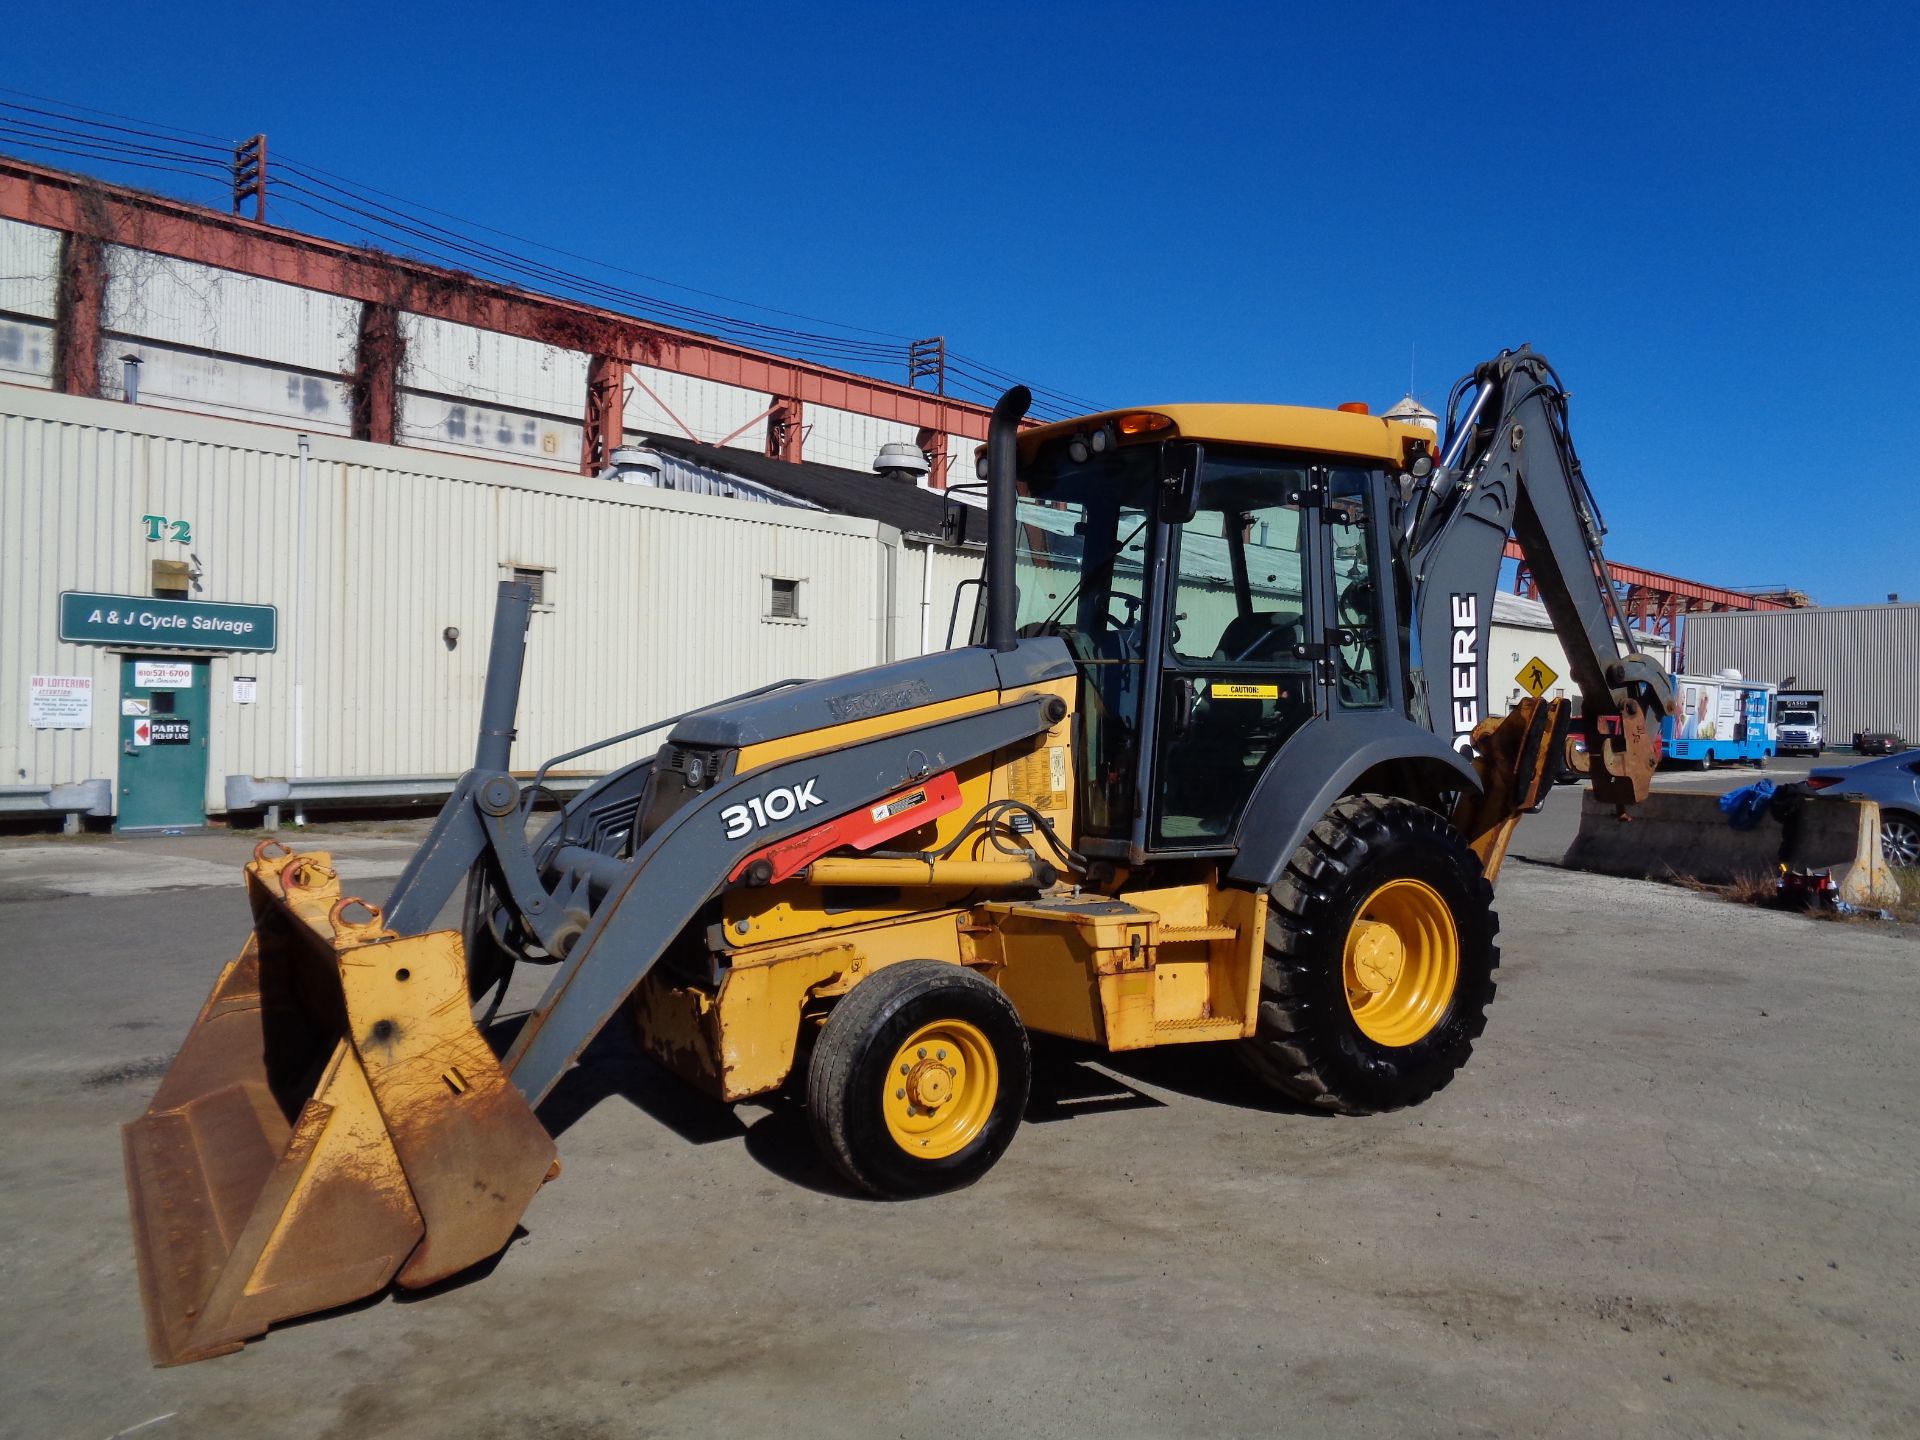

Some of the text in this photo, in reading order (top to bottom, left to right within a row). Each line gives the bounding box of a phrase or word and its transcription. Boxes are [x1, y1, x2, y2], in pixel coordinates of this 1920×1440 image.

[141, 514, 193, 544] T2
[88, 610, 253, 635] A & J Cycle Salvage
[32, 677, 90, 688] NO LOITERING
[719, 777, 824, 840] 310K
